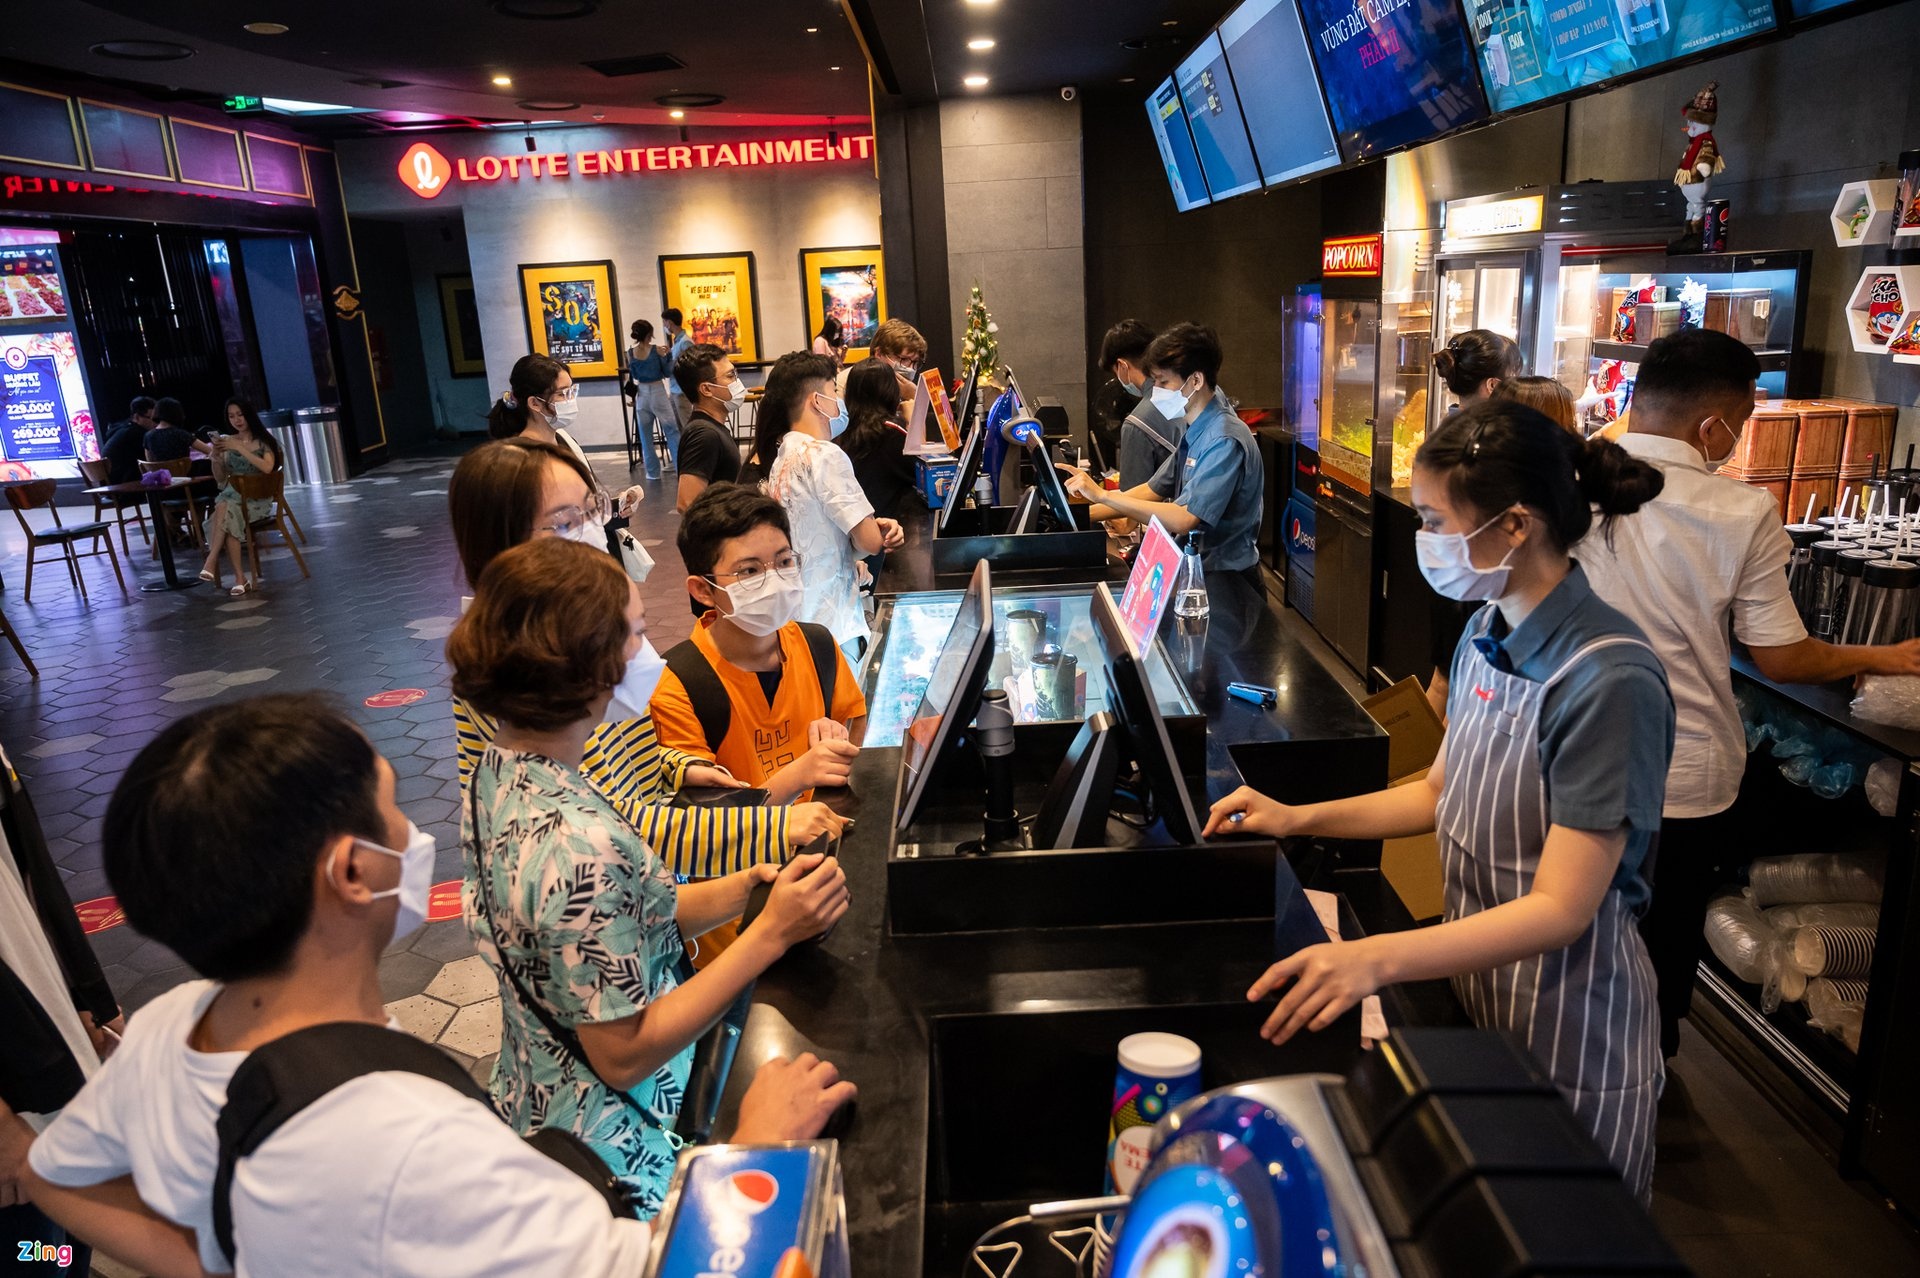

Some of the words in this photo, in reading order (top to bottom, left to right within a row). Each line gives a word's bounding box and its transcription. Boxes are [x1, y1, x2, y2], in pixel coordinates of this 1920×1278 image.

[457, 152, 569, 182] LOTTE
[576, 134, 874, 176] ENTERTAINMENT
[1323, 243, 1375, 271] POPCORN
